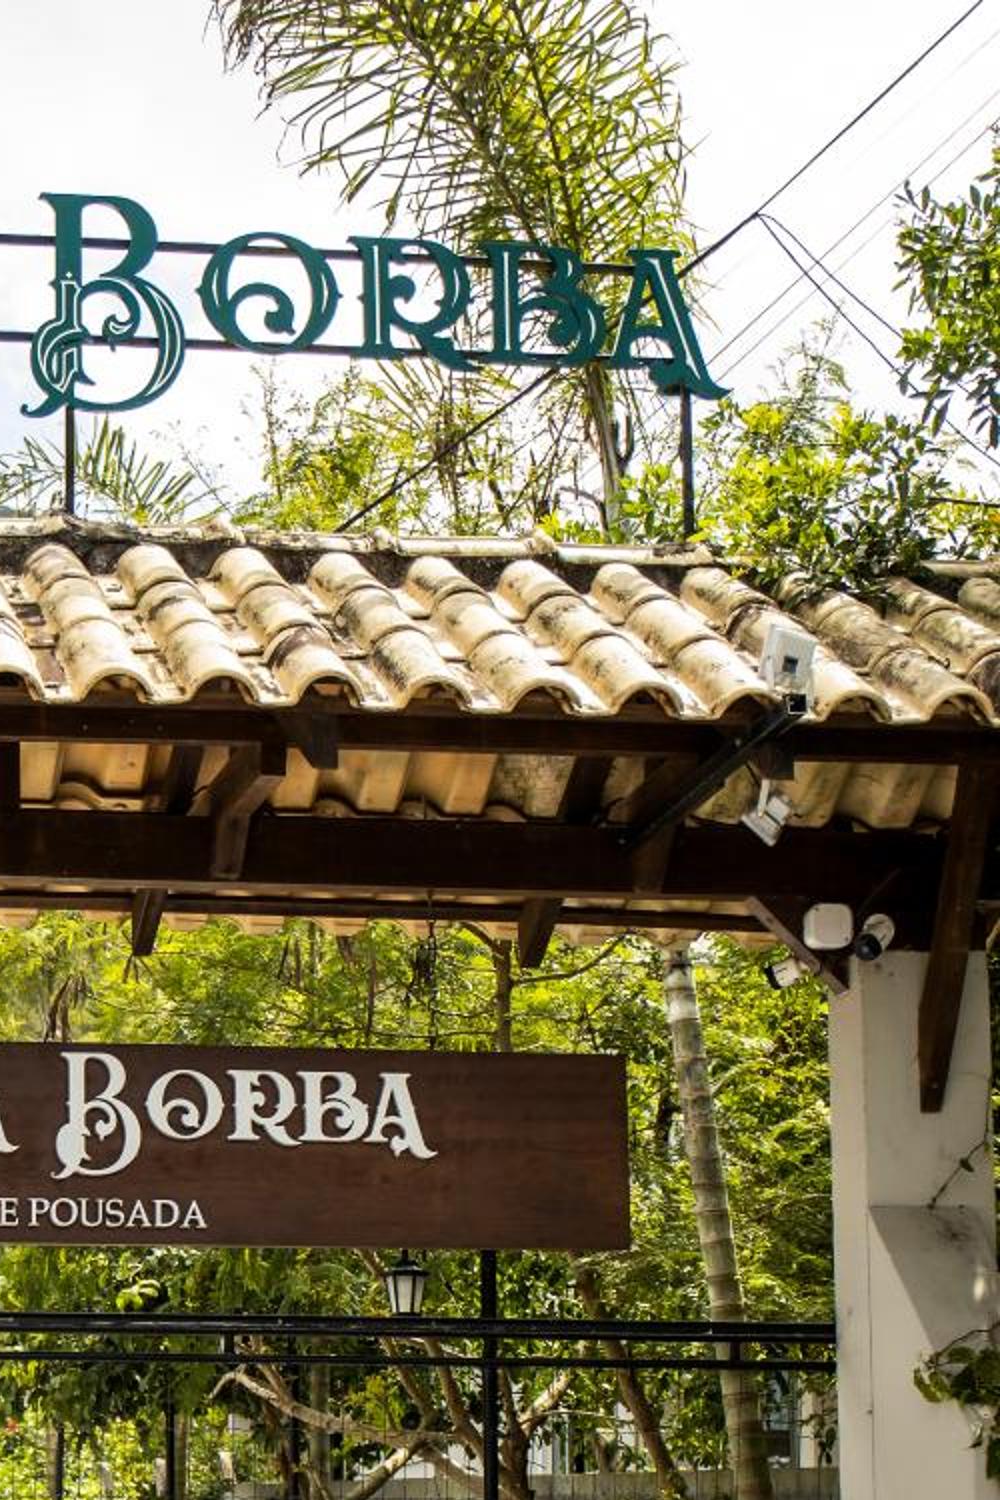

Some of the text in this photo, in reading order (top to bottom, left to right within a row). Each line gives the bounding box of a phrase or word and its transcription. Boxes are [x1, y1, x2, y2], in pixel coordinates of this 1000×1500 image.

[20, 191, 734, 418] BORBA
[49, 1051, 438, 1180] BORBA
[28, 1198, 207, 1229] POUSADA
